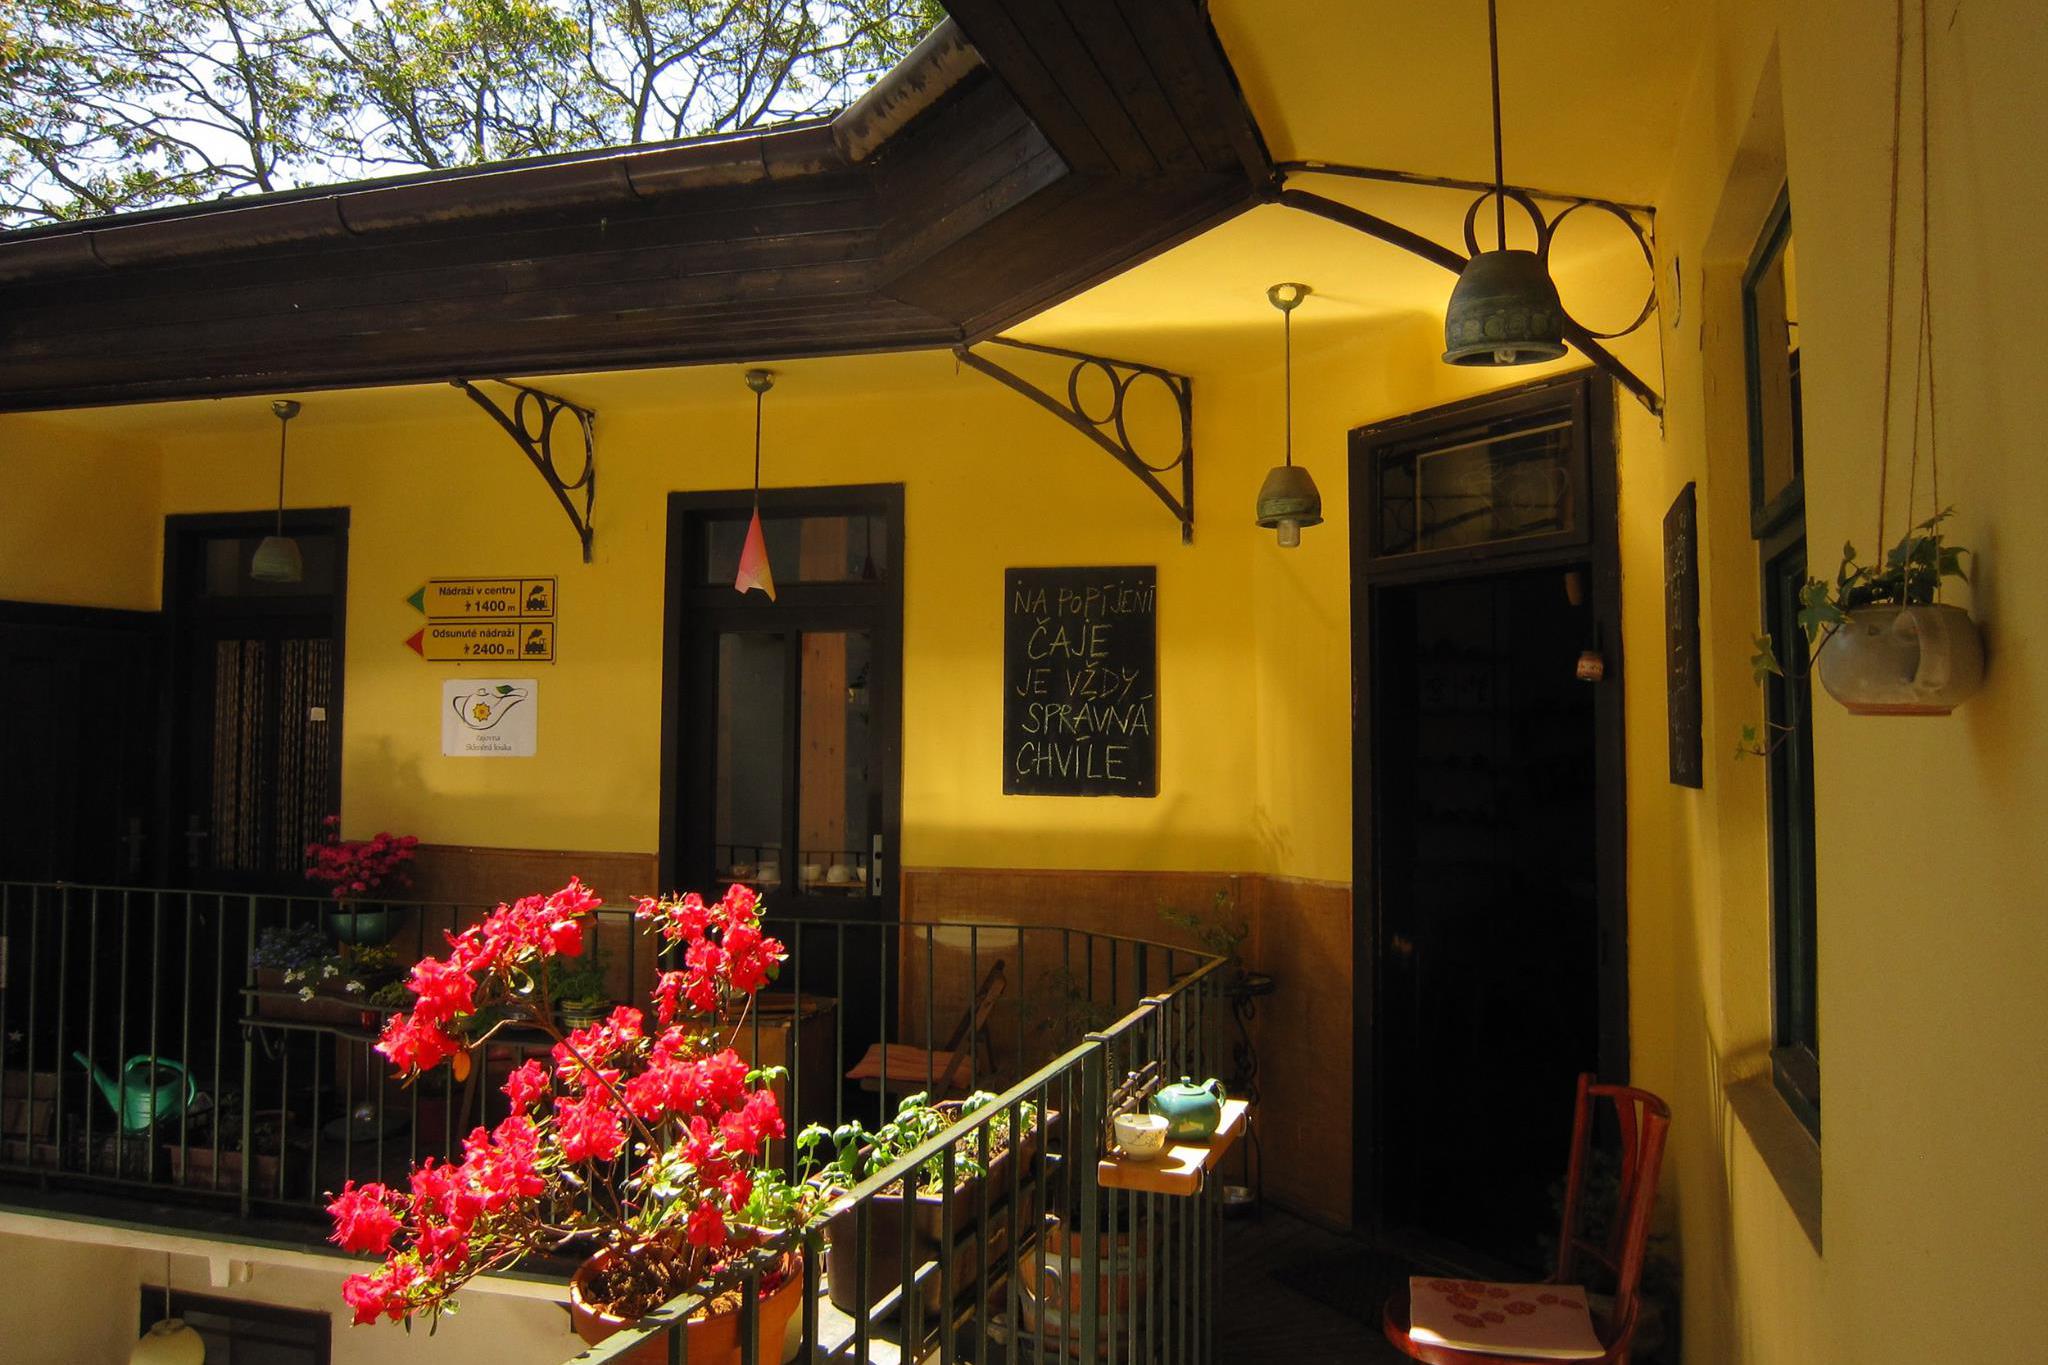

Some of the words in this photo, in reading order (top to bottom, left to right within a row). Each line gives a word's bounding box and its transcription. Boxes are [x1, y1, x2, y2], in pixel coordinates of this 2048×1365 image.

[439, 586, 474, 596] Nádraží
[484, 586, 516, 595] centru
[1014, 588, 1047, 614] NA
[475, 600, 506, 612] 1400
[480, 628, 515, 638] nádraží
[1027, 617, 1112, 660] ČAJE
[473, 644, 505, 655] 2400
[1016, 668, 1051, 696] JE
[1065, 660, 1139, 702] VŽDY
[1021, 694, 1153, 736] SPRÁVNÁ
[1016, 736, 1130, 780] CHVÍLE
